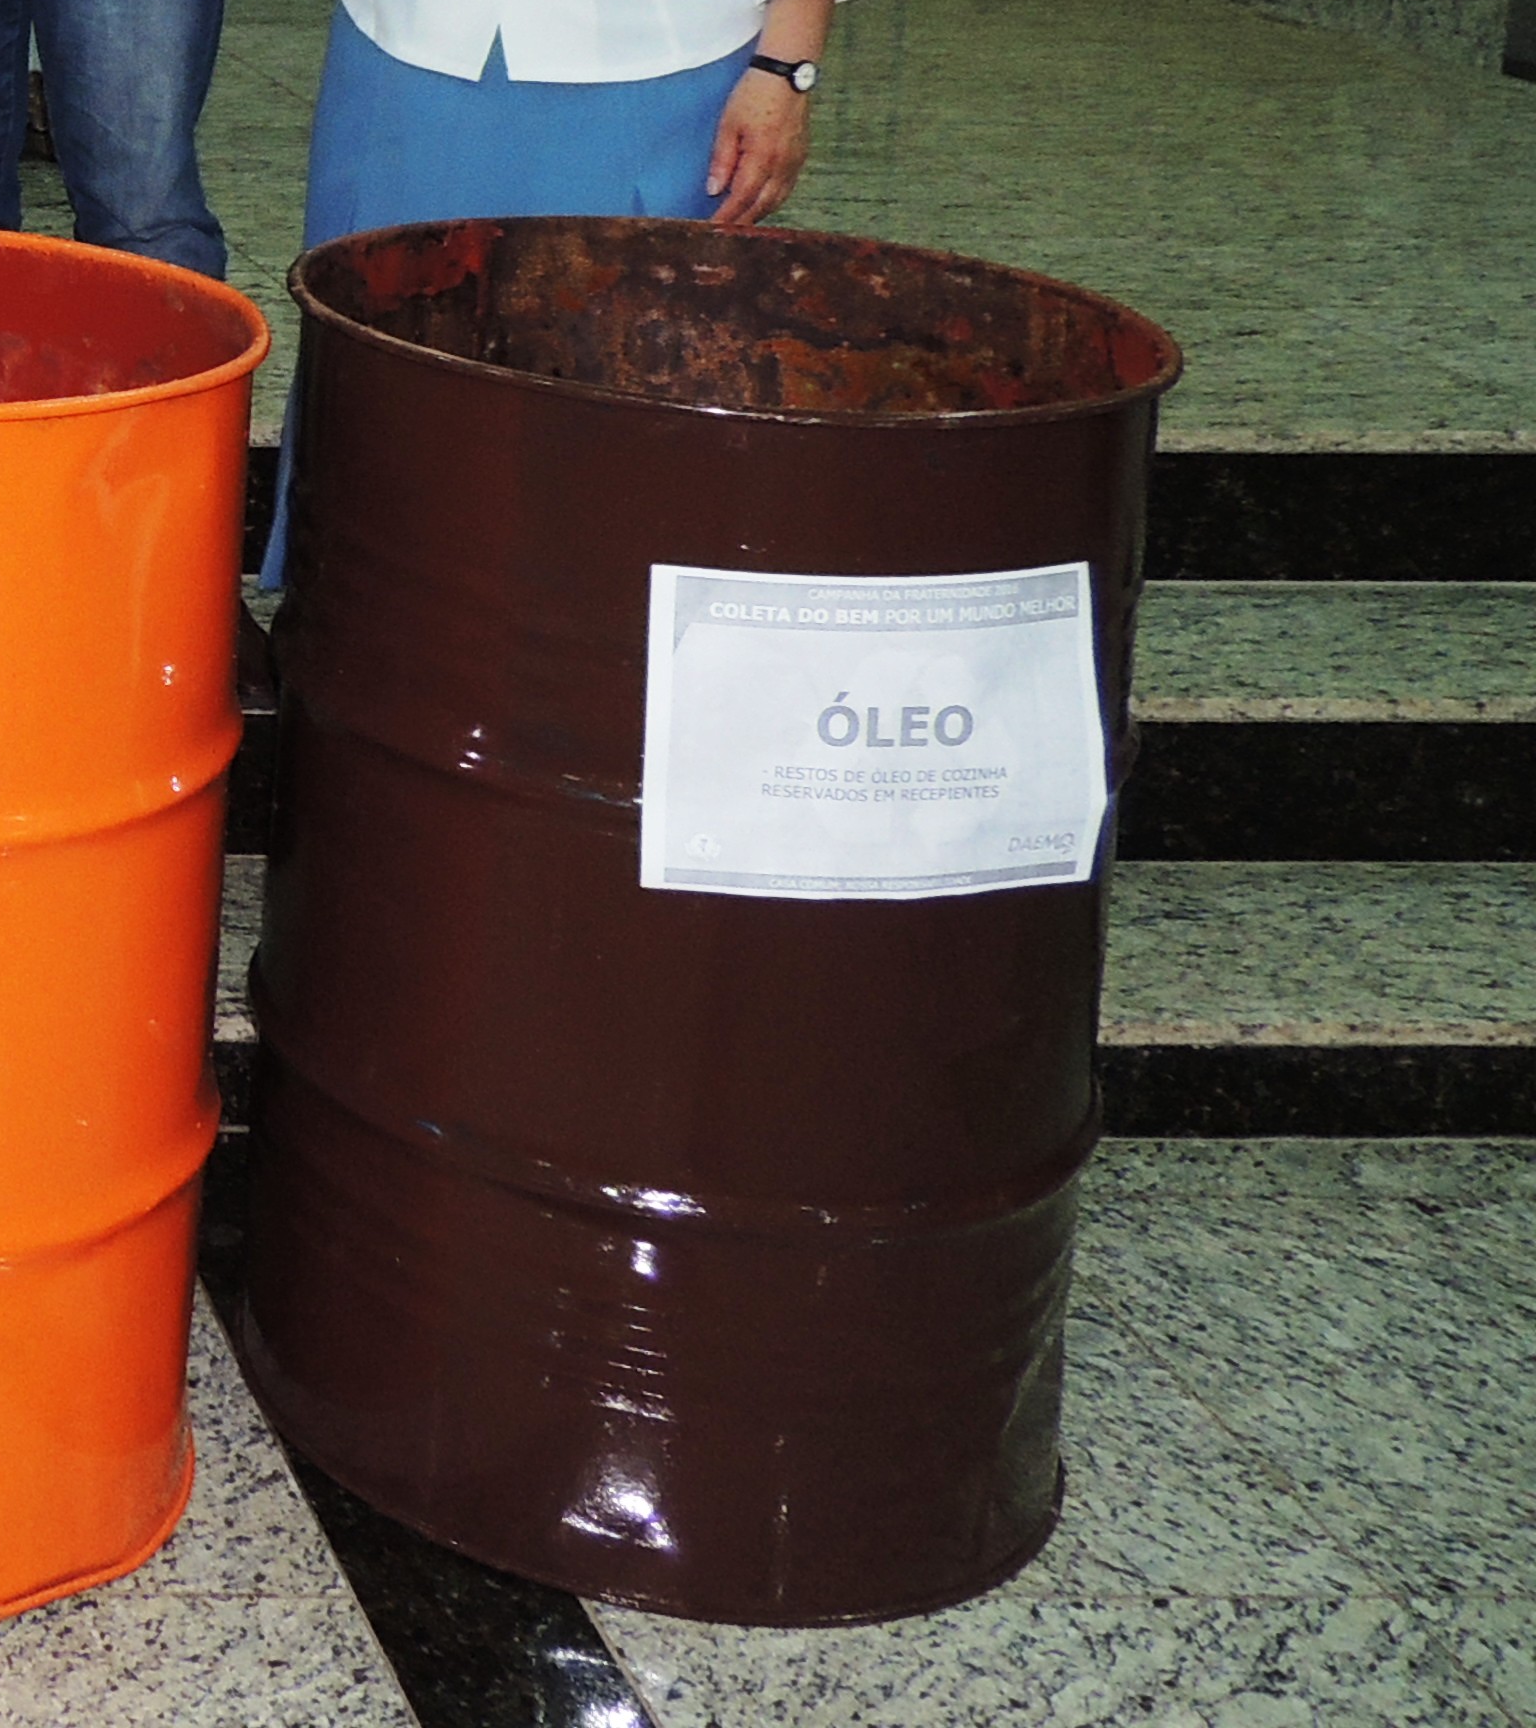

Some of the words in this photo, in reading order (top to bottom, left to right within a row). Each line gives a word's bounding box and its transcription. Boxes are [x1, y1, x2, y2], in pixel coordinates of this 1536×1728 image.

[807, 588, 878, 601] CAMPANHA
[880, 590, 900, 601] DA
[709, 602, 792, 623] COLETA
[798, 608, 829, 625] DO
[835, 608, 878, 625] BEM
[887, 608, 922, 625] POR
[928, 607, 954, 624] UM
[959, 602, 1016, 622] MUNDO
[1019, 595, 1076, 617] MELHOR
[817, 691, 975, 748] ÓLEO
[774, 766, 838, 782] RESTOS
[844, 770, 865, 783] DE
[916, 770, 937, 783] DE
[941, 766, 1008, 782] COZINHA
[762, 783, 869, 803] RESERVADOS
[874, 790, 895, 802] EM
[900, 785, 1000, 802] RECEPIENTES
